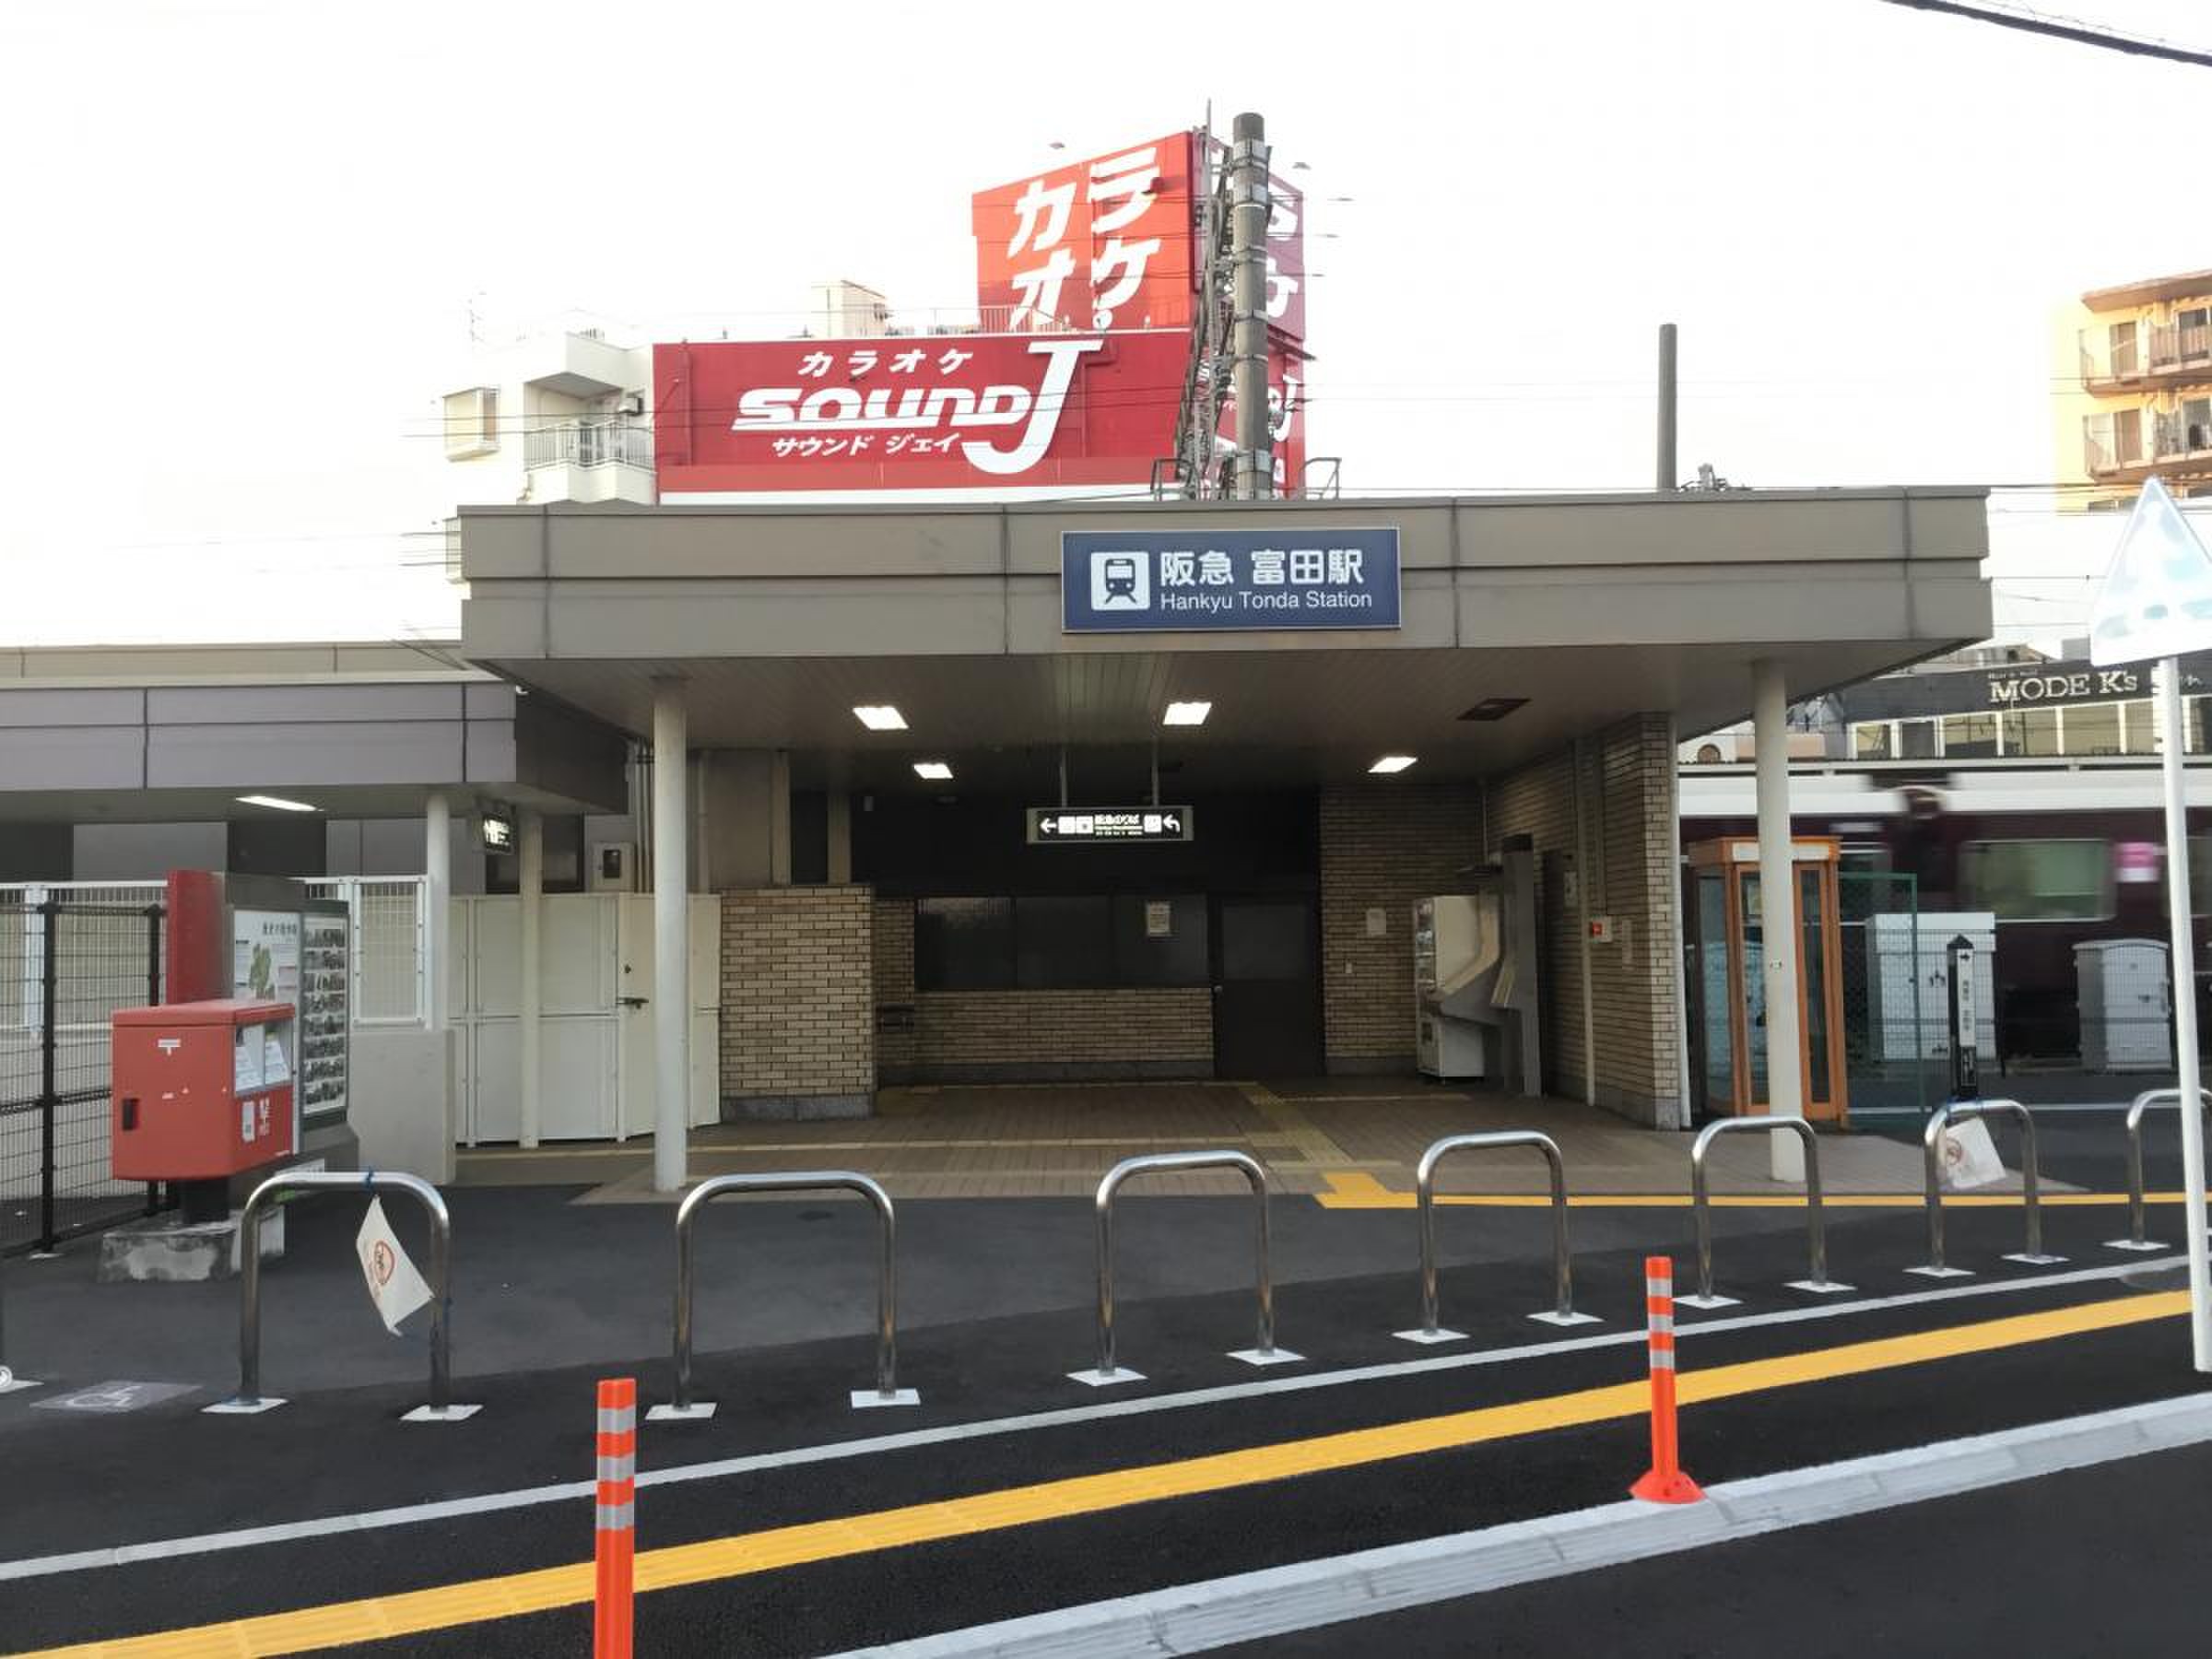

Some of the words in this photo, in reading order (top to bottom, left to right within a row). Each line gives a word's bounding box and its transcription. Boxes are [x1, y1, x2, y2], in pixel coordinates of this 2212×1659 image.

[798, 347, 973, 377] カラオケ
[771, 435, 876, 458] サウンド
[885, 431, 961, 454] ジェイ
[1159, 550, 1235, 586] 阪急
[1250, 548, 1365, 585] 富田駅
[1160, 592, 1233, 615] Hankyu
[1238, 591, 1300, 609] Tonda
[1305, 589, 1372, 608] Station
[1989, 674, 2090, 703] MODE
